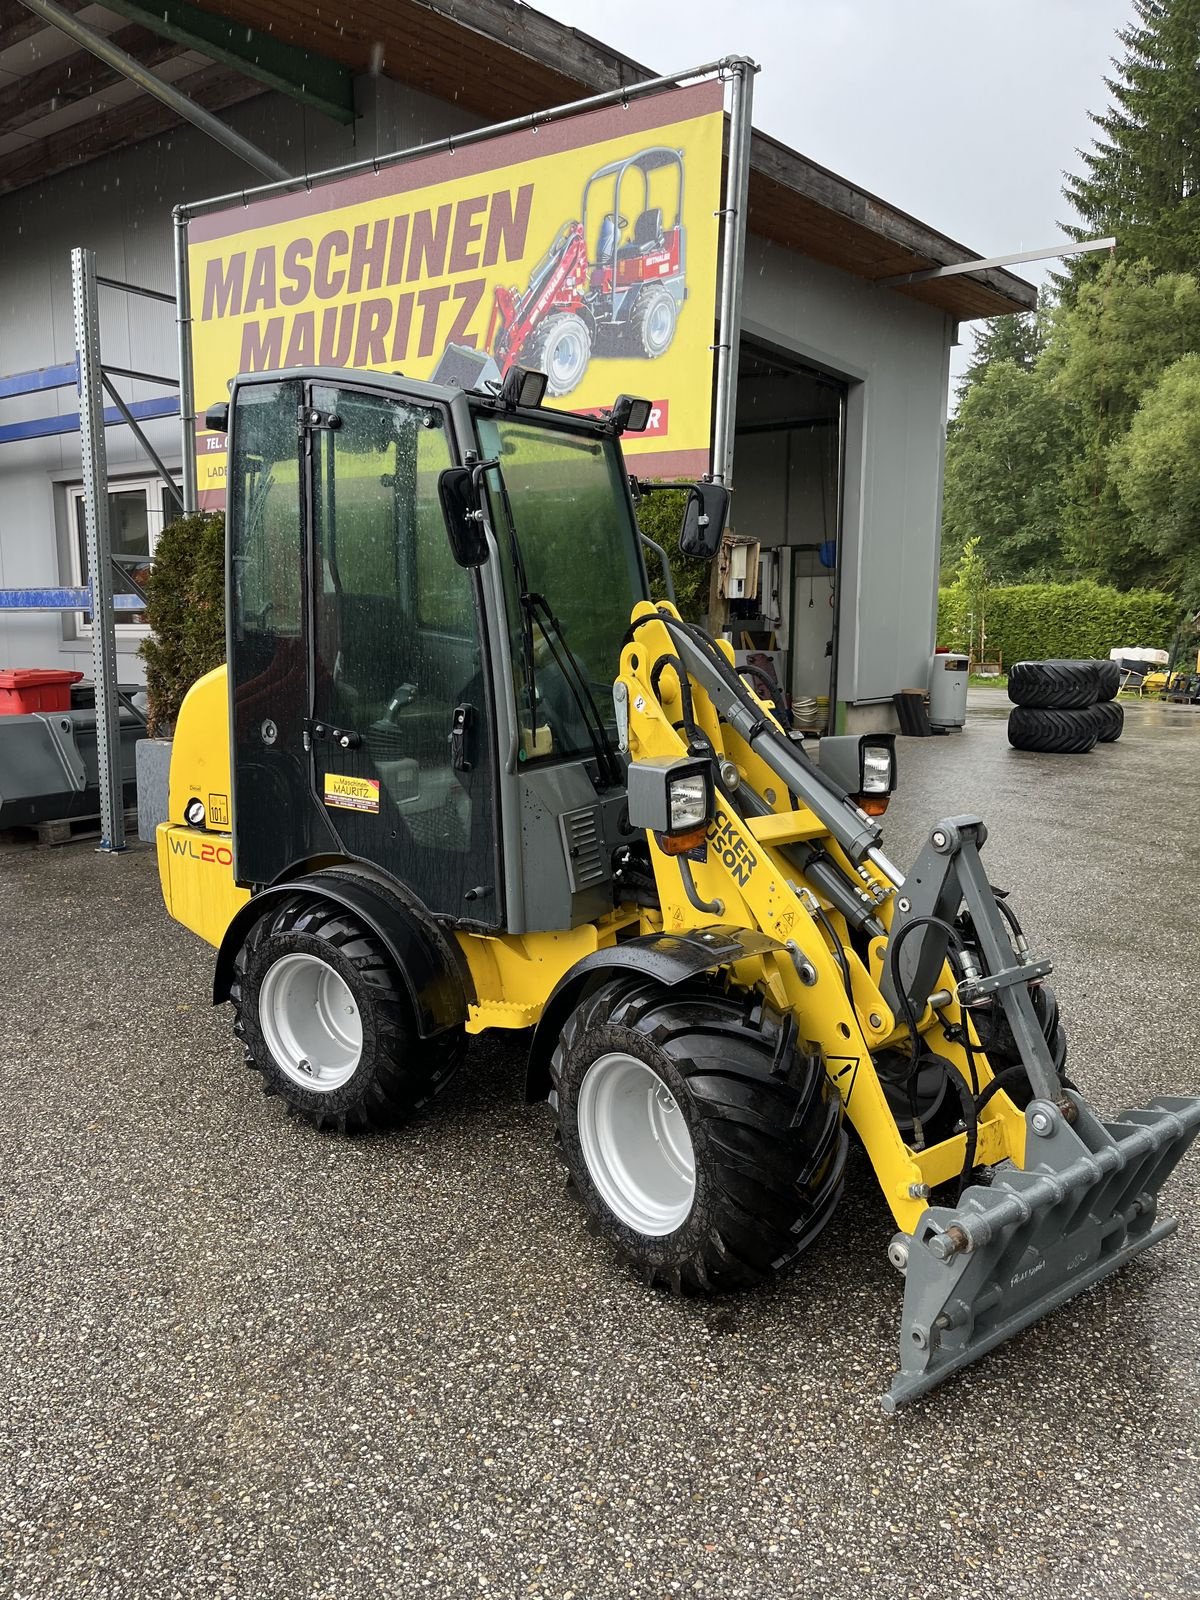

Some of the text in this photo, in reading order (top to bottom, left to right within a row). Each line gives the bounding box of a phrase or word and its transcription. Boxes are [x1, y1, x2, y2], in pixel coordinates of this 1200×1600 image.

[201, 183, 535, 321] MASCHINEN
[239, 278, 487, 373] MAURITZ
[206, 437, 222, 450] TEL.
[211, 807, 222, 822] 101
[333, 784, 369, 798] MAURITZ
[170, 837, 233, 866] WL20
[706, 819, 750, 888] USON
[714, 810, 758, 875] CKER
